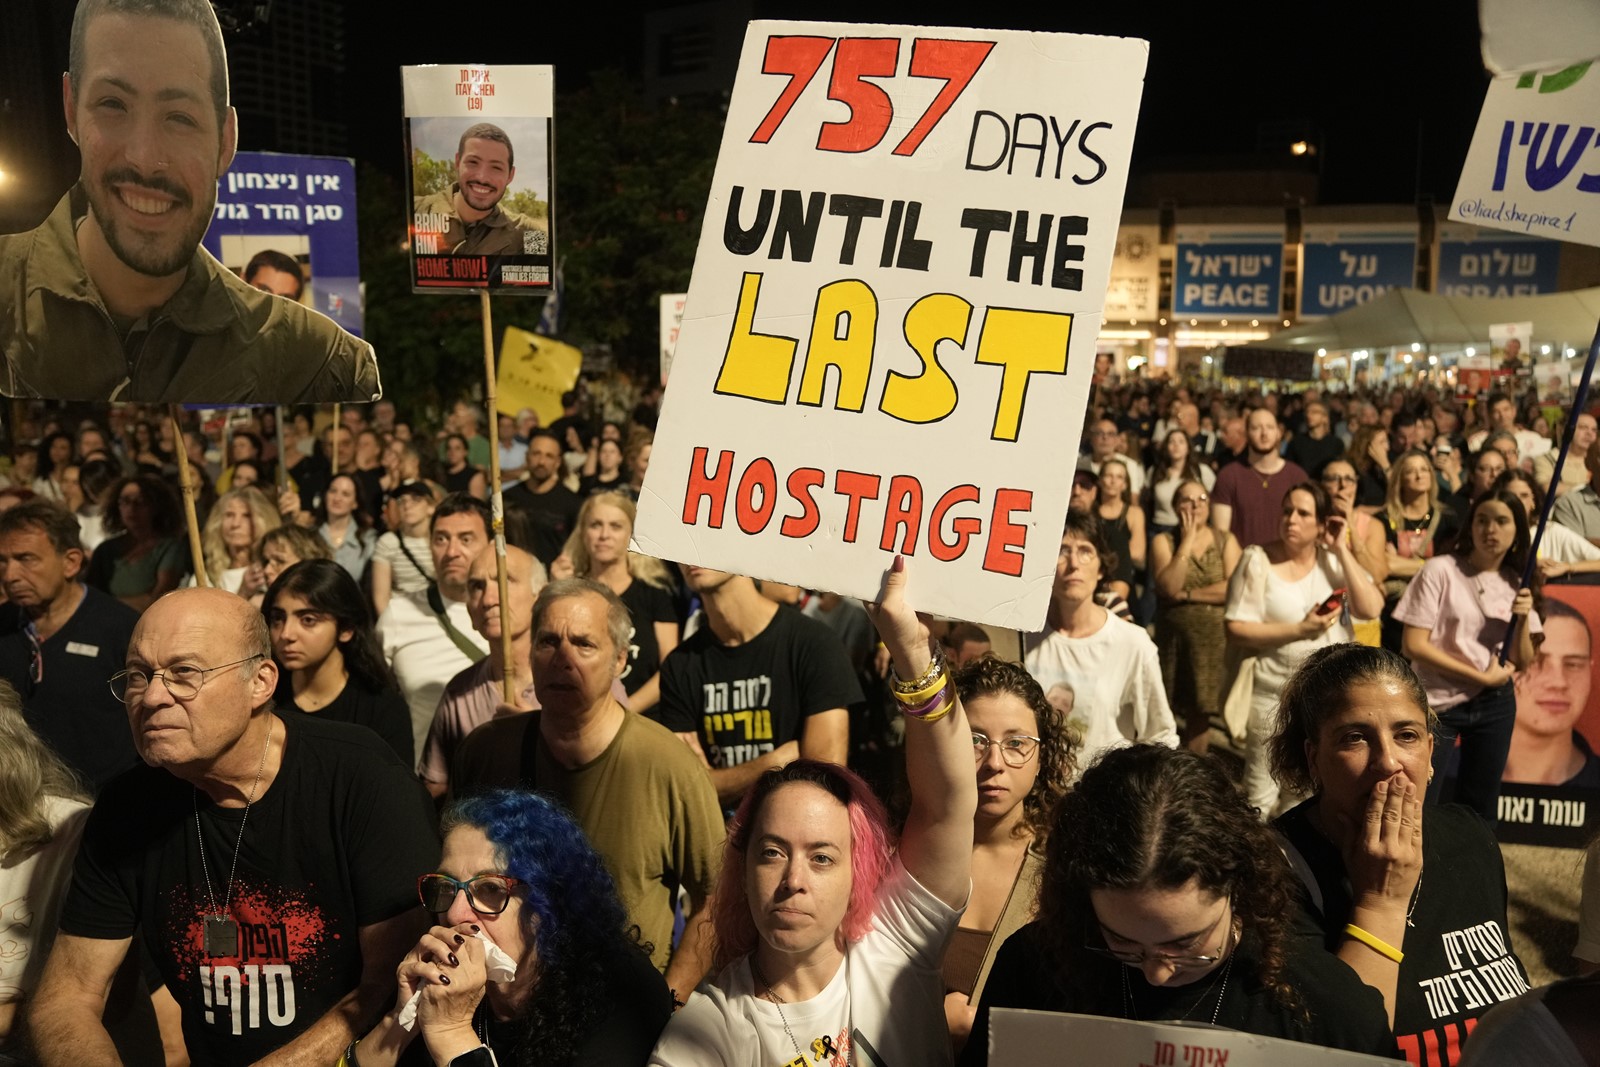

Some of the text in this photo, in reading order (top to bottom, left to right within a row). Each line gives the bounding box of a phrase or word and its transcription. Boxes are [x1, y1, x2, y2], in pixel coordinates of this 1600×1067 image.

[455, 83, 472, 96] ITAY
[460, 69, 469, 83] חן
[467, 97, 483, 111] (19)
[748, 35, 1112, 185] 757 DAYS
[227, 172, 340, 195] אין ניצחון
[216, 202, 343, 225] סגן הדר גול
[415, 213, 450, 234] BRING
[415, 235, 438, 255] HIM
[723, 185, 1089, 291] UNTIL THE
[417, 256, 488, 279] HOME NOW!
[502, 272, 549, 282] FAMILIES FORUM
[1185, 249, 1273, 278] ישראל
[1339, 249, 1378, 278] על
[1460, 248, 1536, 277] שלום
[1183, 283, 1270, 307] PEACE
[713, 272, 1074, 442] LAST
[681, 446, 1033, 578] HOSTAGE
[733, 675, 772, 711] למה
[704, 709, 773, 745] עדיין
[1539, 798, 1586, 827] עומר
[199, 964, 296, 1036] סוף!
[1418, 969, 1494, 1020] הביתה
[1154, 1041, 1175, 1067] חן
